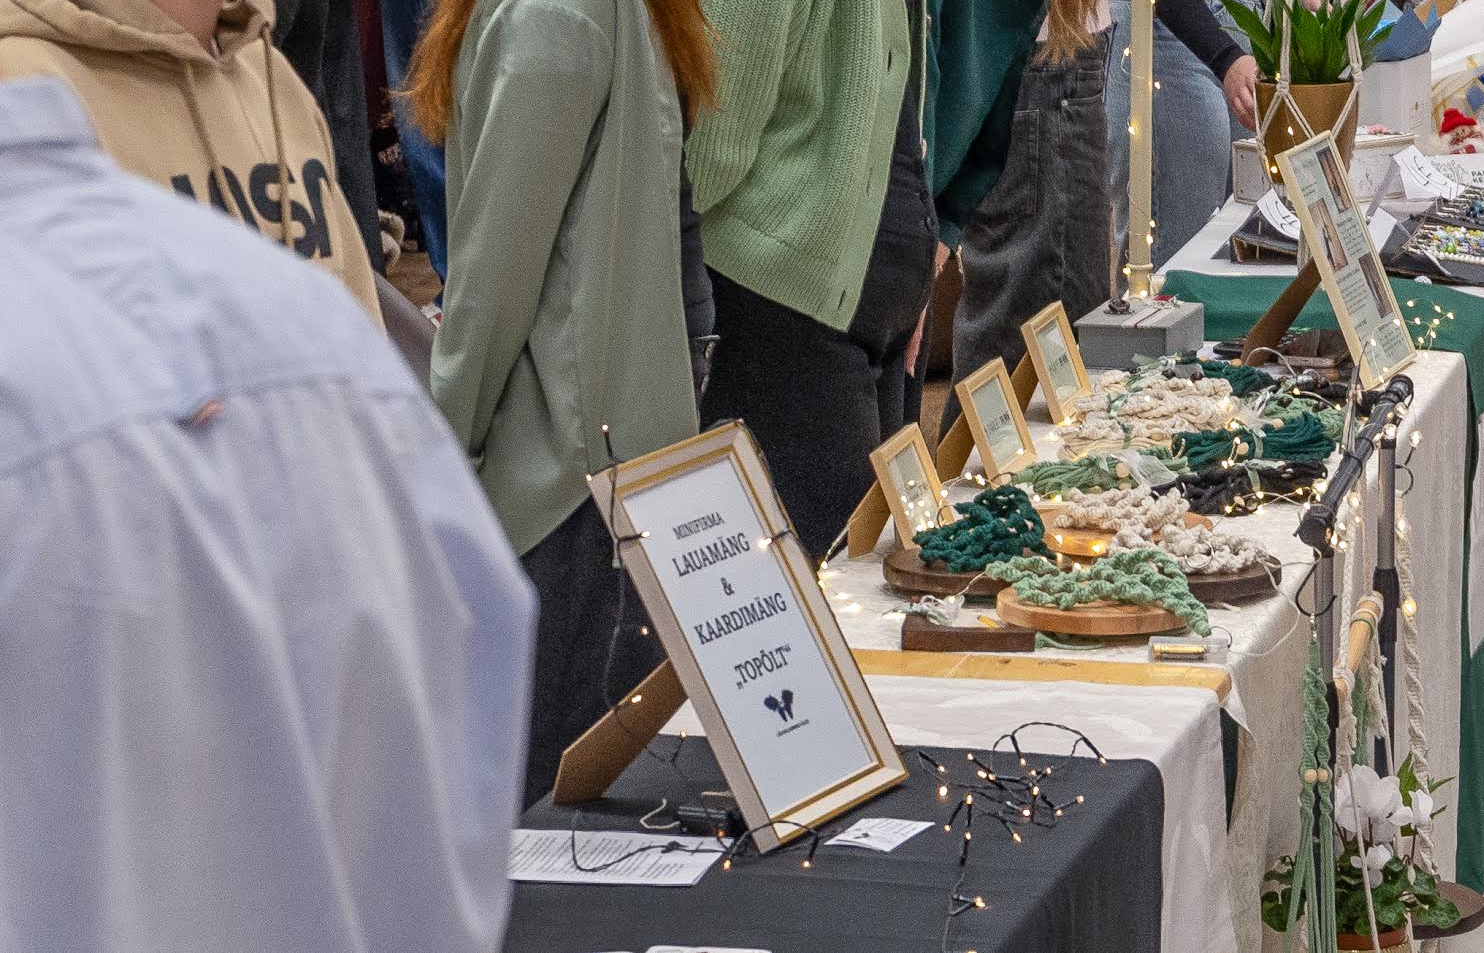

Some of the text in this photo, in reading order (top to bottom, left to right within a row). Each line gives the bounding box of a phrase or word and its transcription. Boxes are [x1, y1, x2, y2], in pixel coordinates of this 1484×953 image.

[672, 532, 751, 577] LAUAMÄNG
[720, 577, 735, 597] &
[694, 592, 788, 645] KAARDIMÄNG
